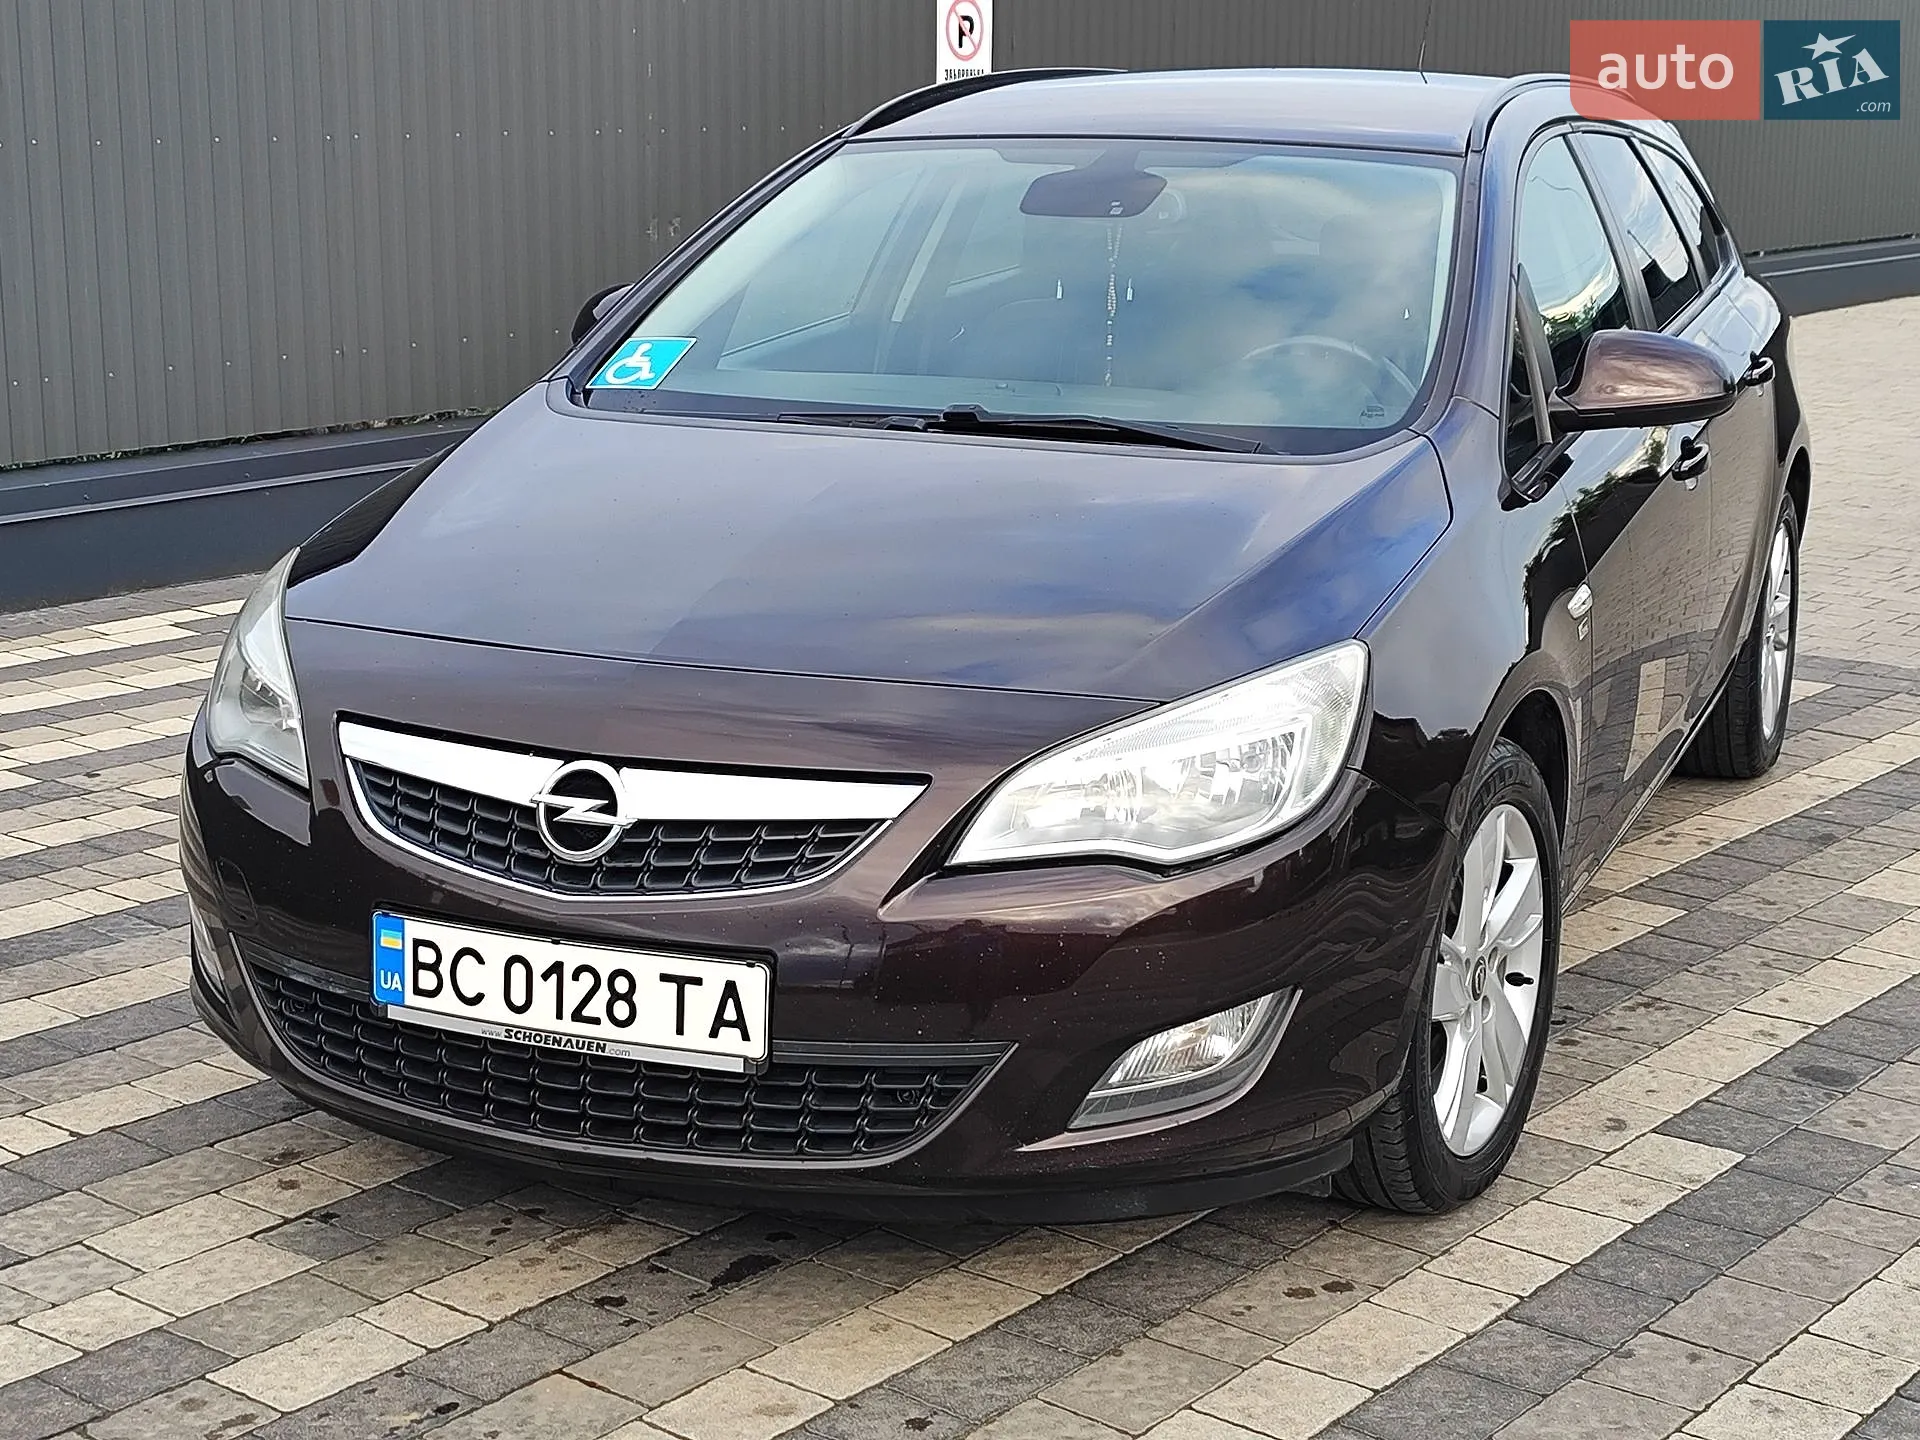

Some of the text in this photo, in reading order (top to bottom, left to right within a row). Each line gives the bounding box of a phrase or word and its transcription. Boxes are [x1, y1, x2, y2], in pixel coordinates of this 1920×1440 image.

[380, 969, 403, 992] UA
[412, 937, 751, 1042] BC 0128 TA
